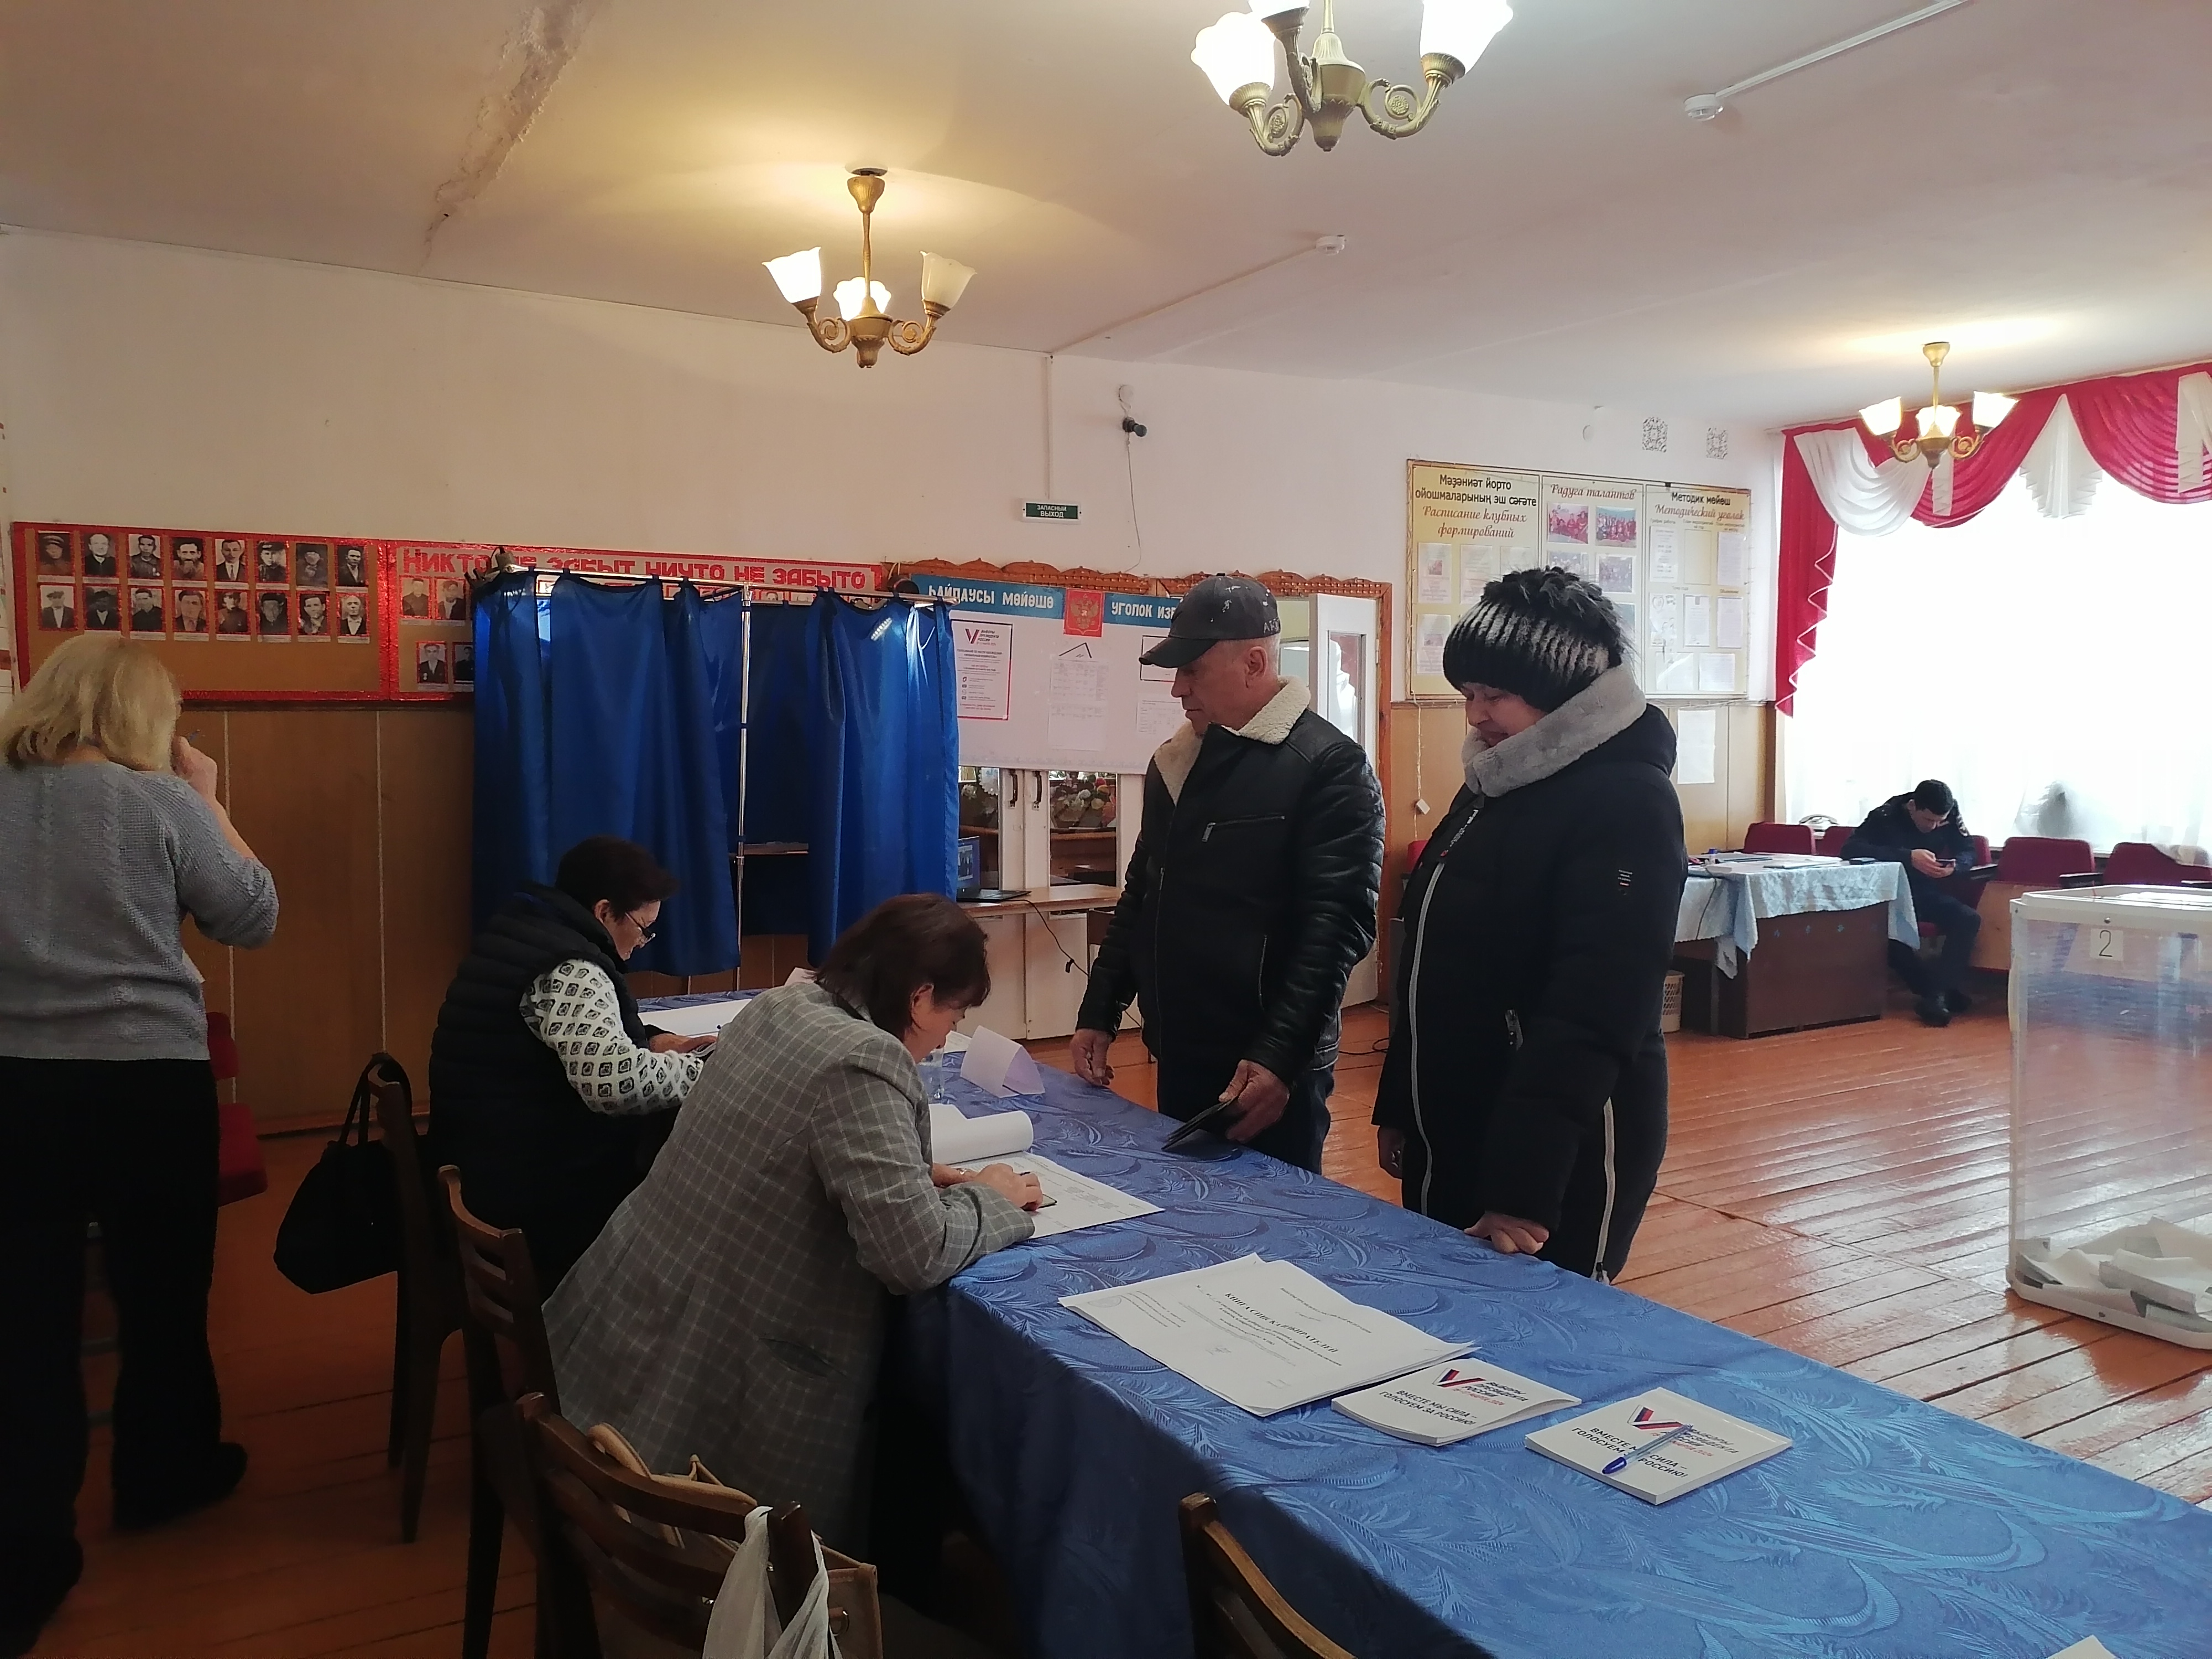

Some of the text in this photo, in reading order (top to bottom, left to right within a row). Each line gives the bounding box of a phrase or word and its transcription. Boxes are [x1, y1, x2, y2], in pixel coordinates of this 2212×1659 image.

[1486, 478, 1511, 491] йорто
[1551, 484, 1637, 500] Радуга талантов
[1415, 487, 1491, 504] ойошмаларының
[1494, 495, 1506, 504] эш
[1671, 492, 1704, 504] Методик
[1422, 505, 1527, 524] Расписание клубных
[1717, 509, 1745, 521] уголок
[1437, 522, 1516, 539] формирований
[645, 561, 725, 581] НИЧТО
[734, 565, 765, 583] НЕ
[772, 568, 865, 589] ЗАБЫТО
[1111, 602, 1154, 618] УГОЛОК
[2099, 930, 2112, 957] 2
[1224, 1292, 1250, 1311] КНИГА
[1379, 1391, 1424, 1411] ГОЛОСУЕМ
[1433, 1410, 1477, 1426] РОССИЮ!
[1396, 1390, 1431, 1405] ВМЕСТЕ
[1431, 1401, 1448, 1410] МЫ
[1446, 1405, 1469, 1418] СИЛА
[1572, 1427, 1688, 1479] ГОЛОСУЕМ РОССИЮ!
[1589, 1427, 1631, 1448] ВМЕСТЕ
[1649, 1454, 1679, 1468] СИЛА
